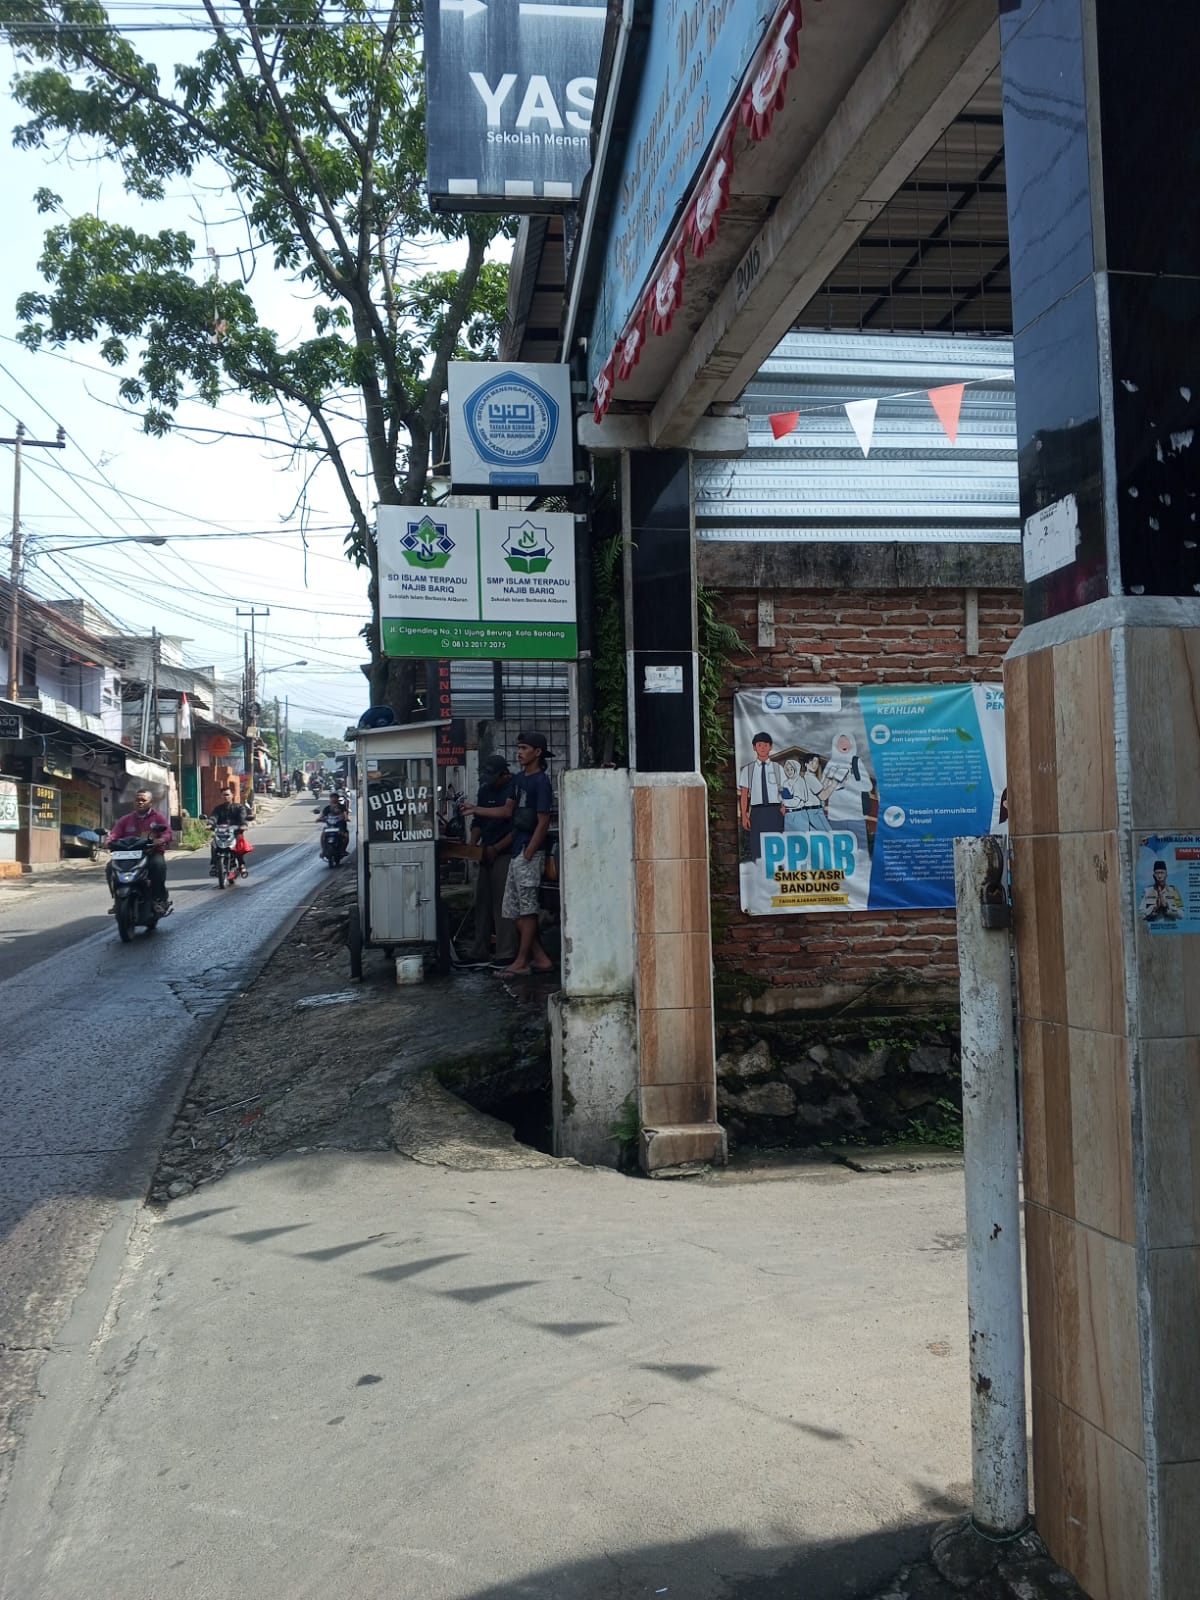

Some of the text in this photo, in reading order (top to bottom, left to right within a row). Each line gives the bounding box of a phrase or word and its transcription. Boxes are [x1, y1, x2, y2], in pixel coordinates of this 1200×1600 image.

[487, 130, 541, 144] Sekolah
[387, 574, 468, 585] SD ISLAM TERPADU
[486, 577, 570, 587] SMP ISLAM TERPADU
[401, 583, 455, 594] NAJIB BARIQ
[503, 586, 555, 595] NAJIB BARIQ
[399, 626, 438, 636] Cigending
[464, 629, 485, 638] Ujung
[533, 630, 565, 638] Bandung
[787, 695, 833, 704] SMK YASRI
[876, 706, 925, 715] KEAHLIAN
[368, 786, 428, 811] BUBUR
[386, 802, 428, 817] AYAM
[909, 806, 977, 816] Desain Komunikasi
[909, 817, 932, 825] Visual
[392, 829, 433, 841] KUNING
[764, 834, 856, 879] PPDB
[774, 870, 845, 882] SMKS YASRI
[780, 881, 840, 893] BANDUNG
